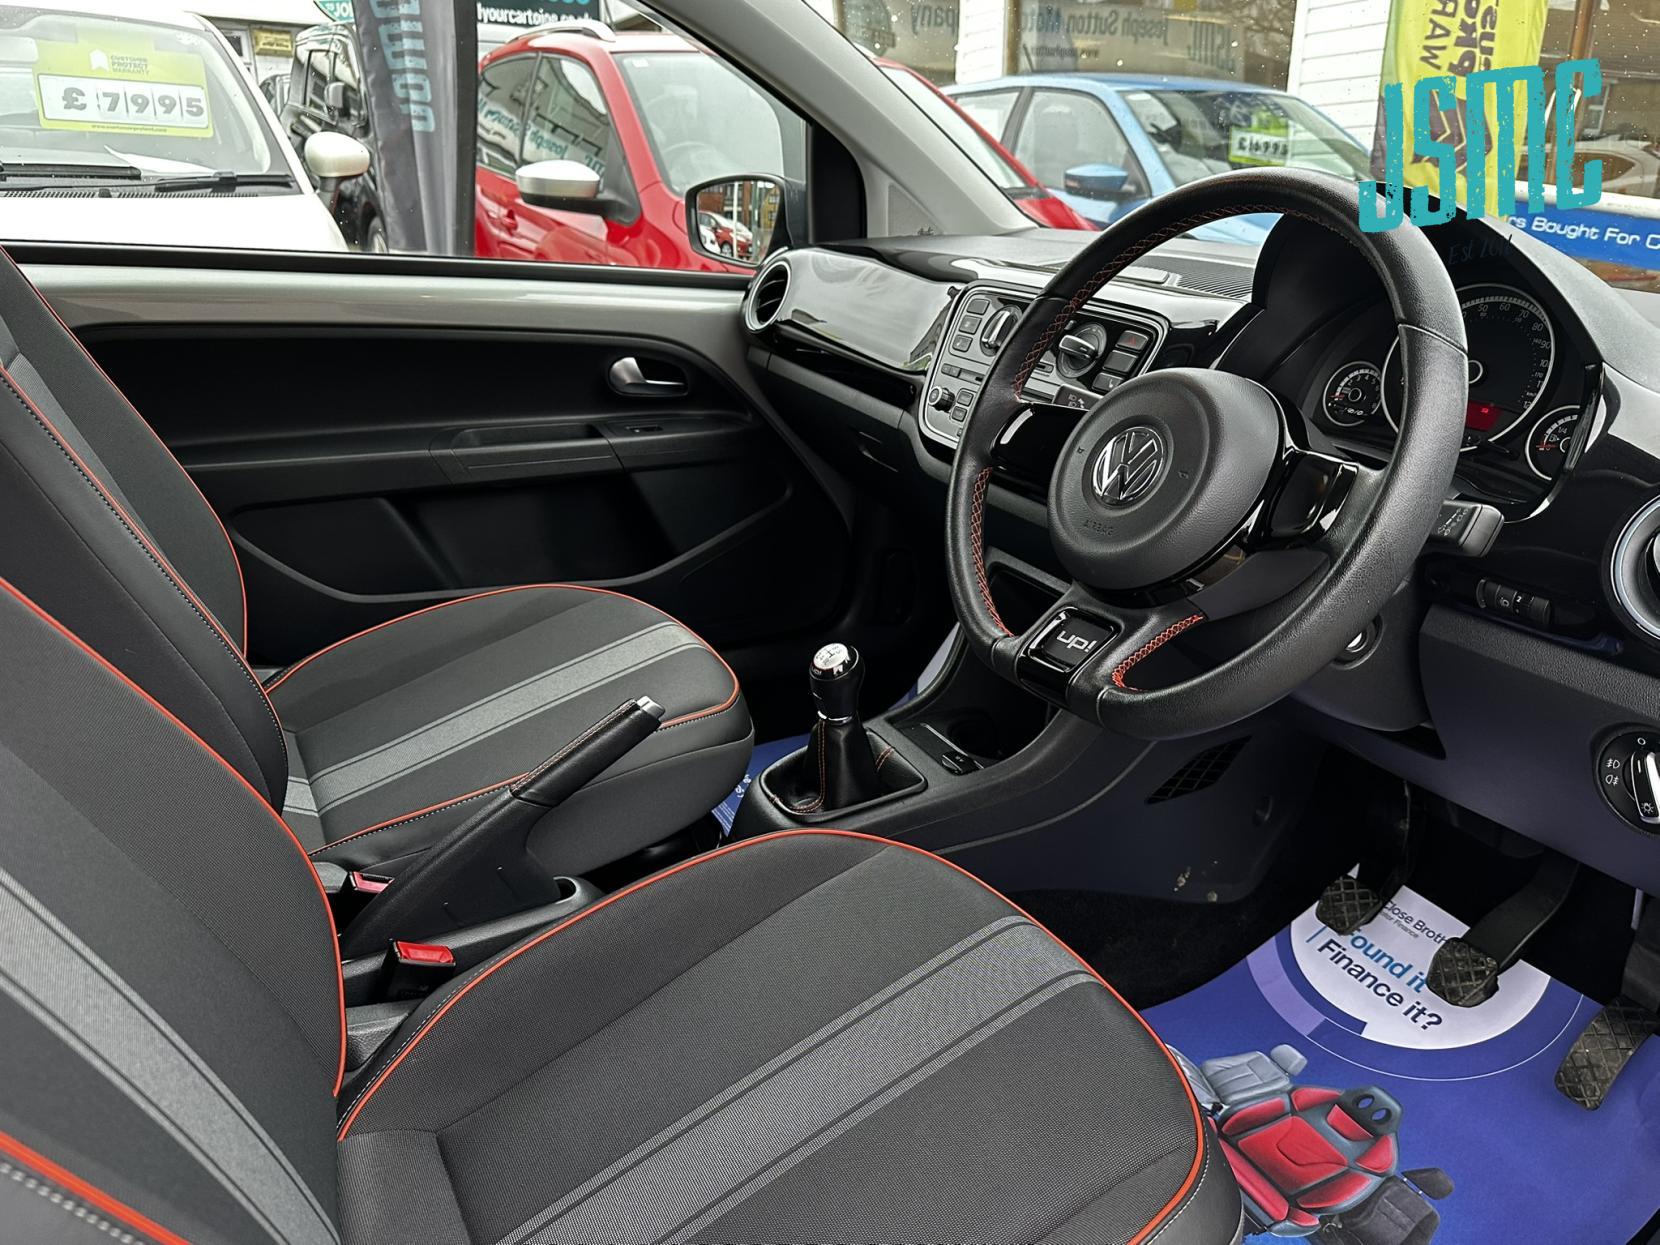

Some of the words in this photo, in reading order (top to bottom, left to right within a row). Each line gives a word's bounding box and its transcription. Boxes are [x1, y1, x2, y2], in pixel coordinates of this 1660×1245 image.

[1508, 216, 1526, 229] rs
[1532, 216, 1600, 239] Bought
[1604, 227, 1640, 245] For
[1499, 303, 1511, 311] 60
[1532, 322, 1544, 332] 80
[1540, 341, 1552, 349] 90
[1057, 629, 1098, 653] up!
[1413, 920, 1449, 944] Broth
[1350, 929, 1413, 979] ound
[1317, 938, 1404, 1007] Finance
[1402, 1000, 1443, 1030] it?
